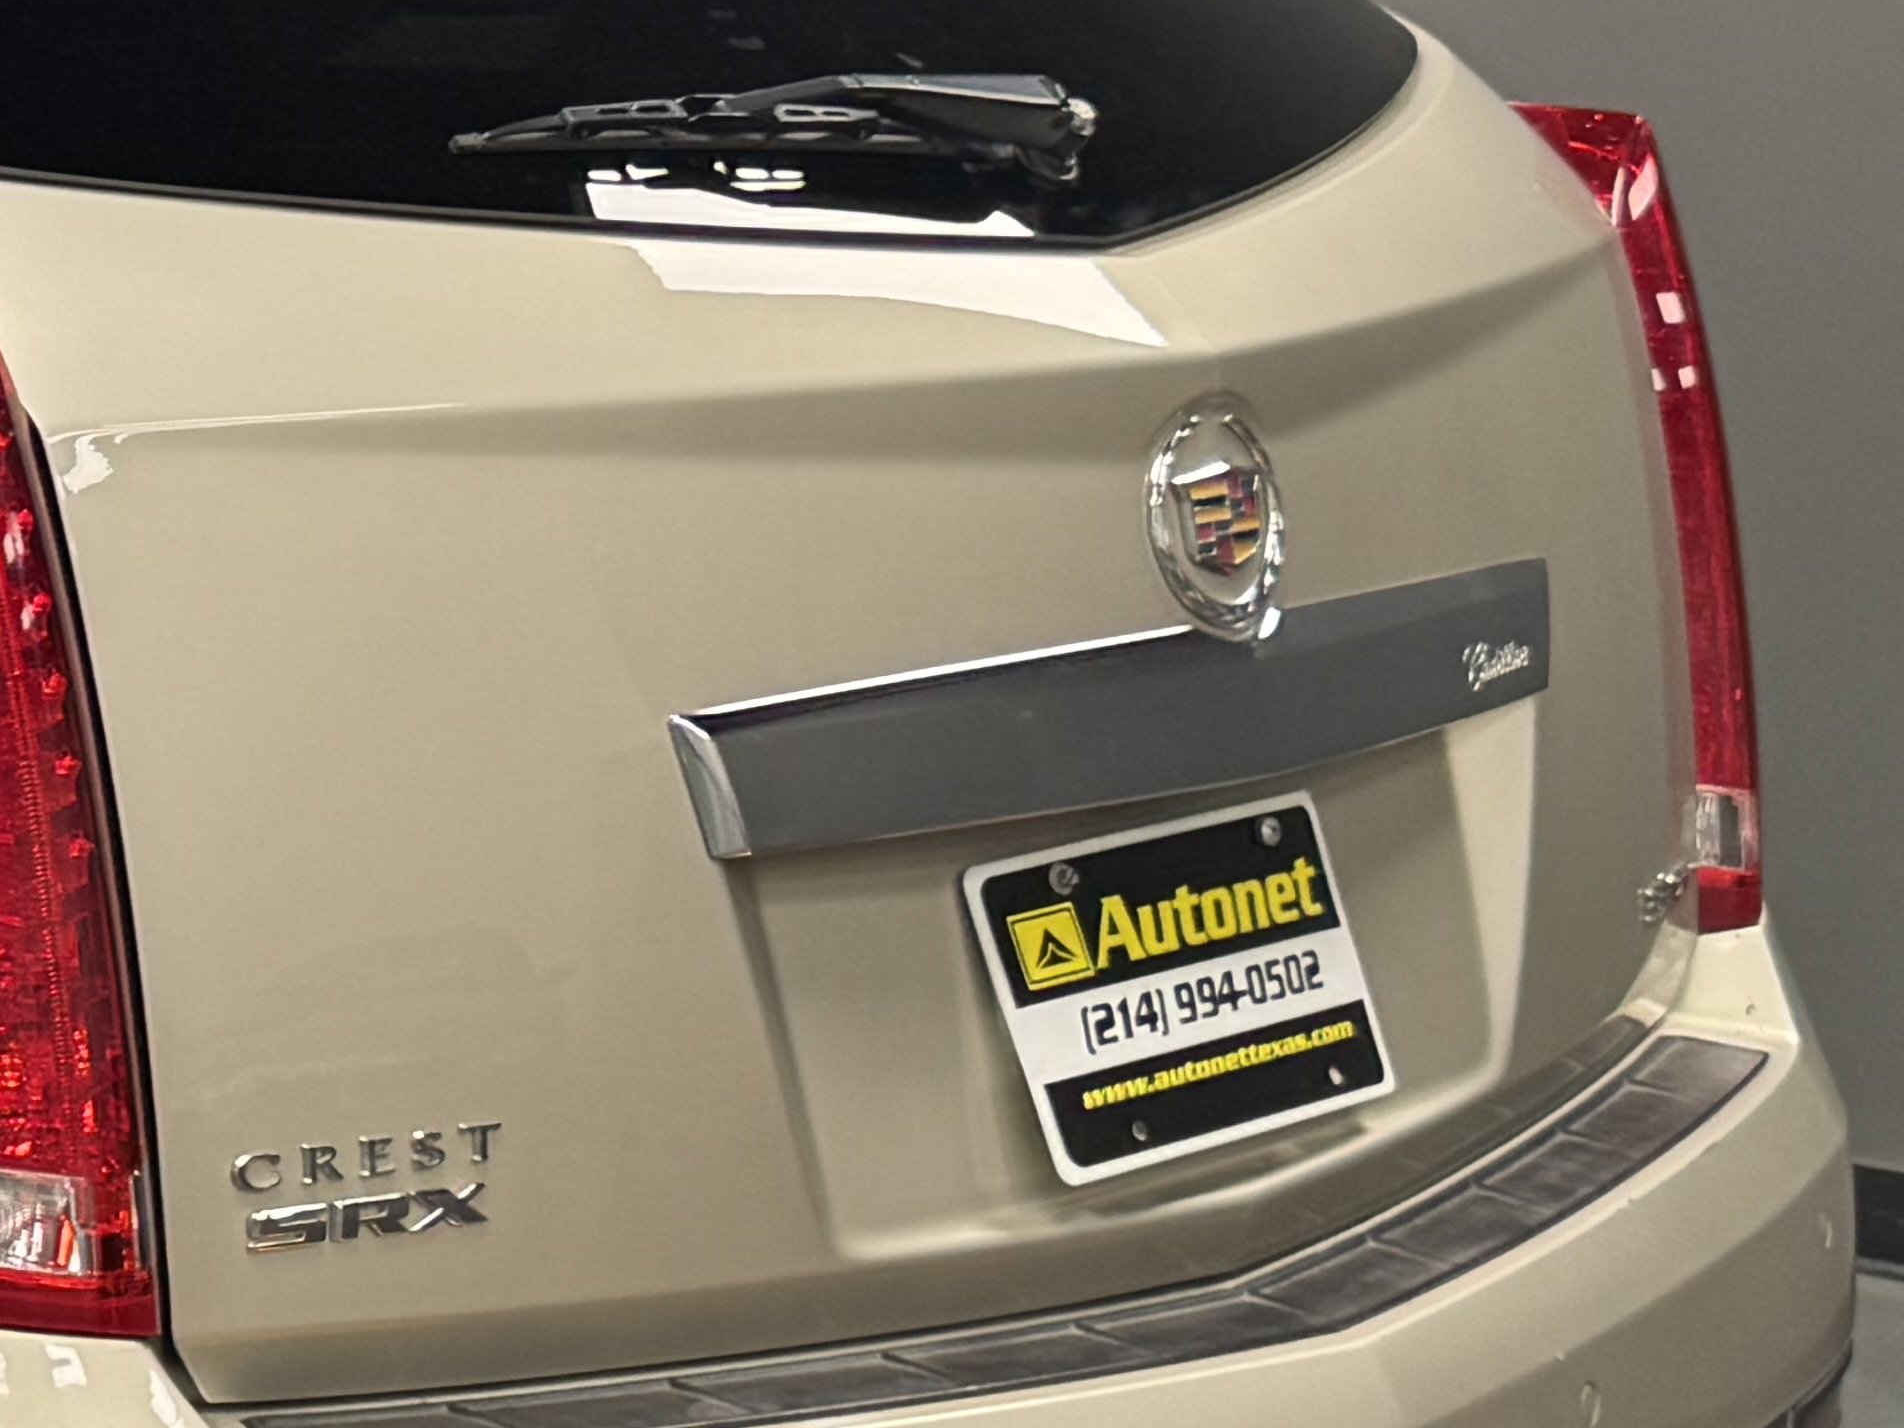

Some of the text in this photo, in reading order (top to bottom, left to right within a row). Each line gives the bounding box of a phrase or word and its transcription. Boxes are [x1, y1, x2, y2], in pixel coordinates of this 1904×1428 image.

[1096, 856, 1324, 970] Autonet
[1080, 949, 1324, 1055] (214) 994-0502
[1082, 1019, 1356, 1110] www.autonettexas.com
[229, 1121, 503, 1193] CREST
[245, 1181, 490, 1254] SRX
